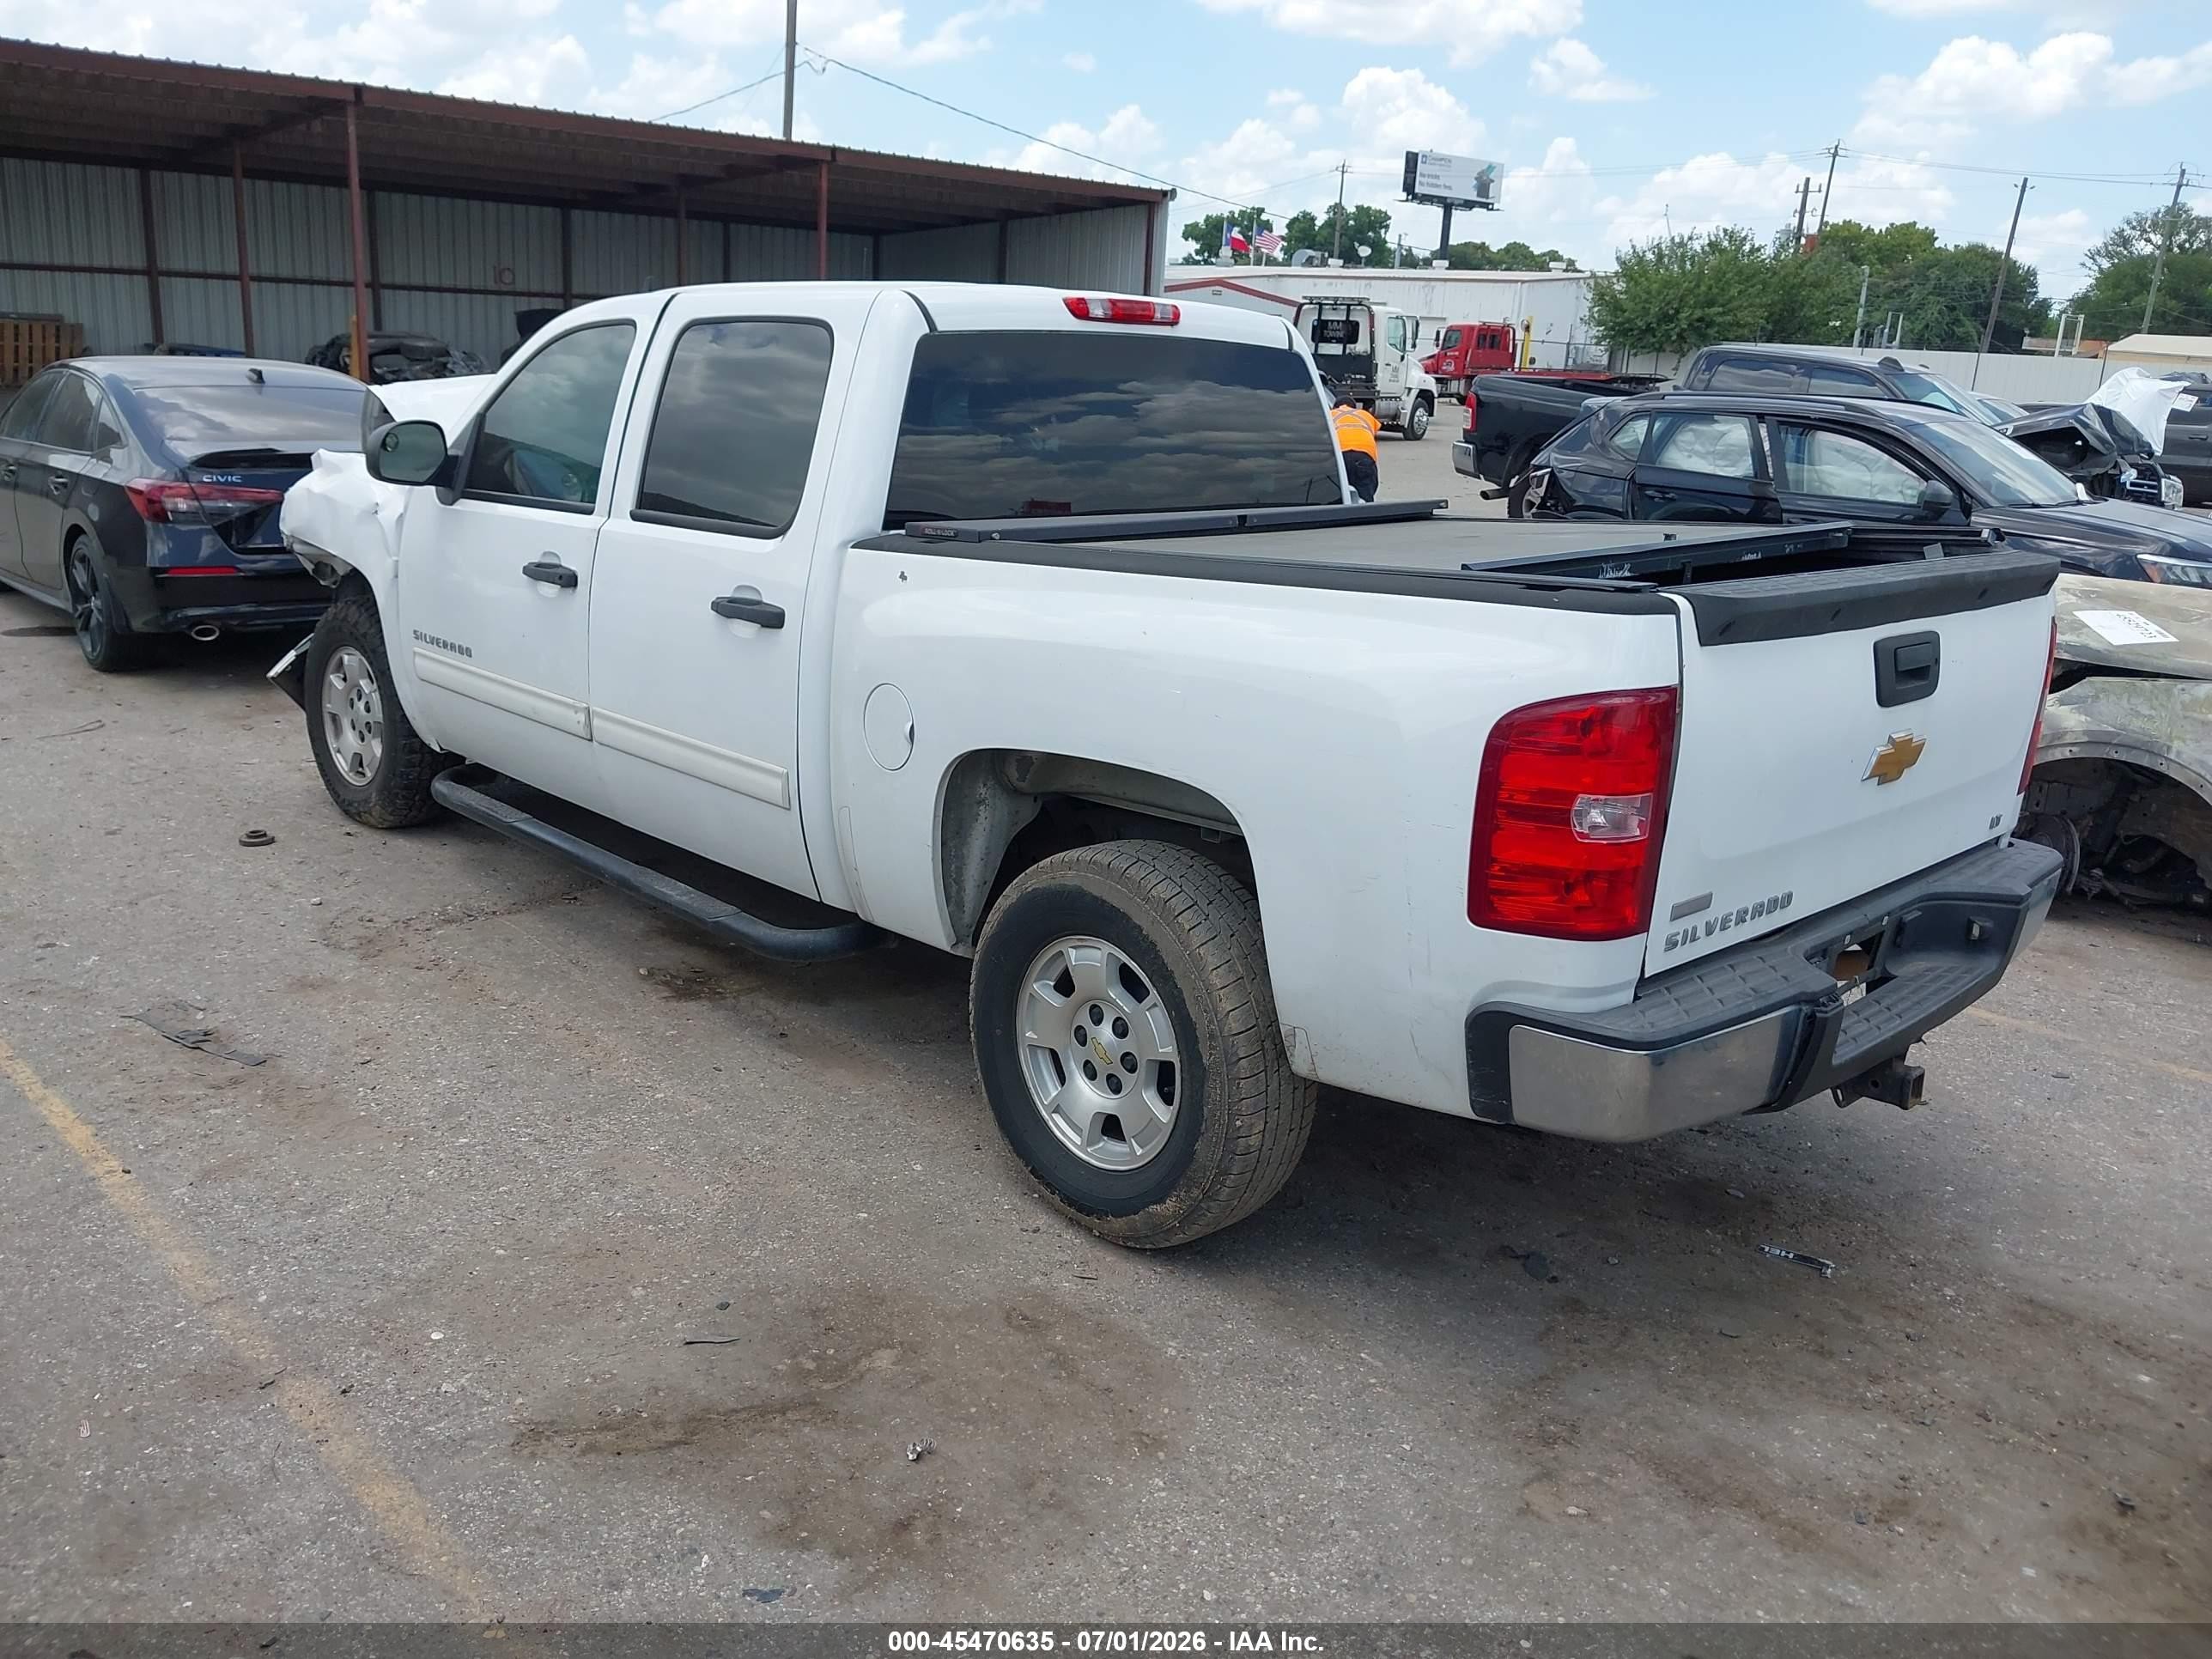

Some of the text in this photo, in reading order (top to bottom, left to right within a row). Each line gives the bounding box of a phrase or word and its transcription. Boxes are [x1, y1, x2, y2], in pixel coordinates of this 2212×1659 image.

[203, 474, 242, 483] CIVIC
[413, 629, 473, 658] SILVERADO
[1664, 890, 1794, 952] SILVERADO
